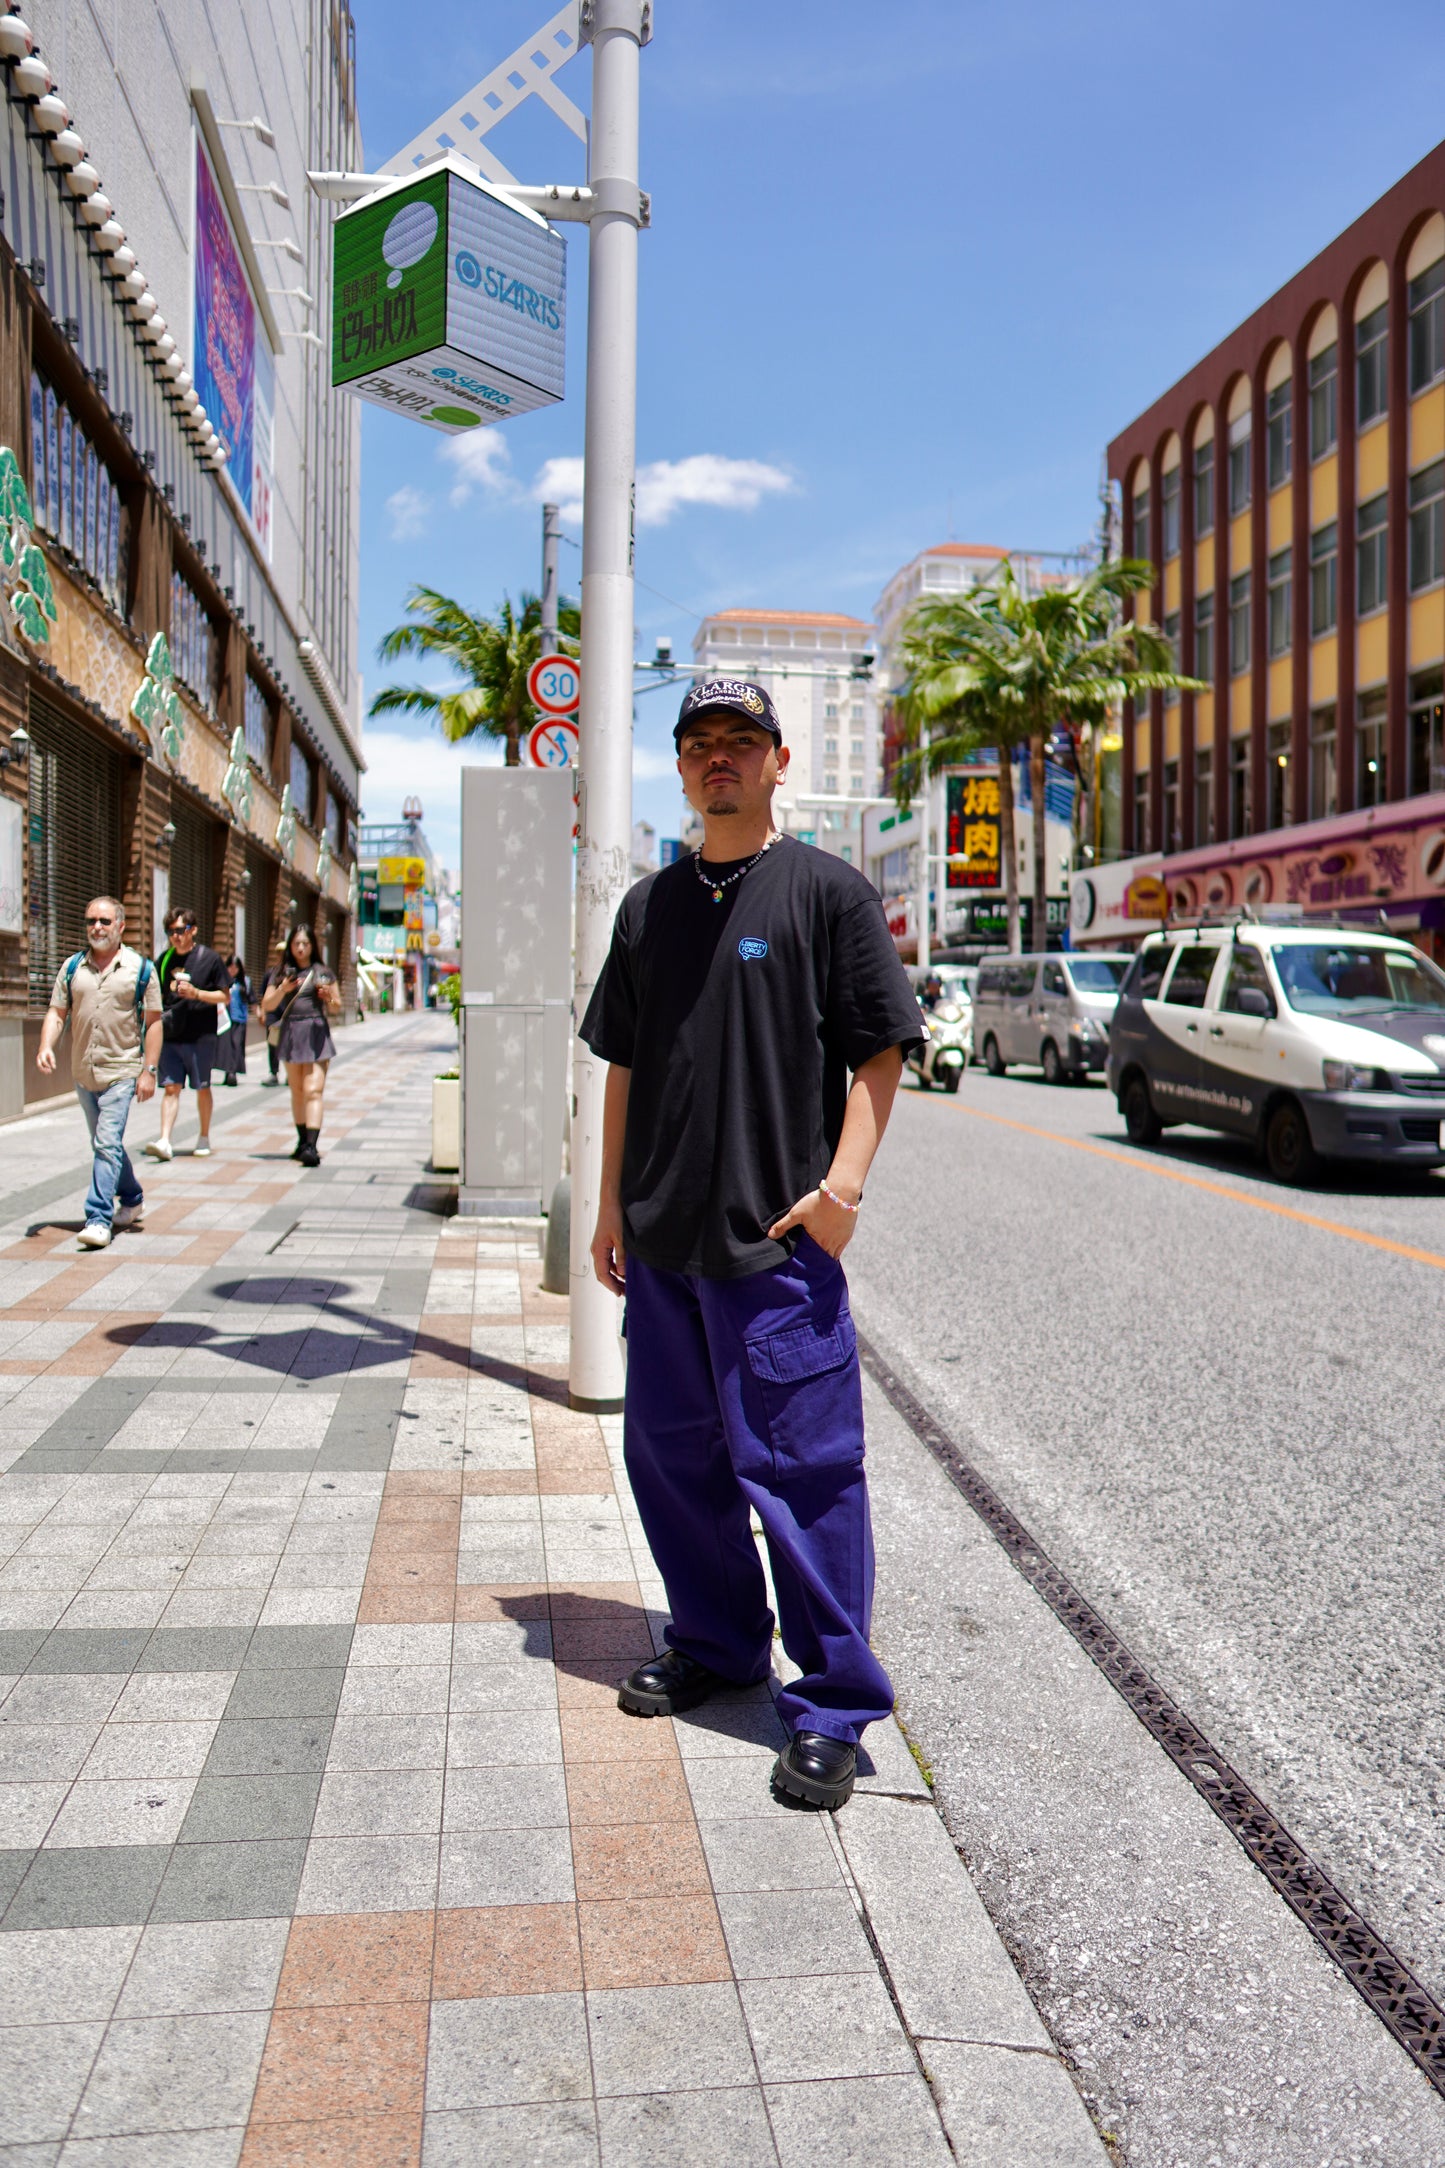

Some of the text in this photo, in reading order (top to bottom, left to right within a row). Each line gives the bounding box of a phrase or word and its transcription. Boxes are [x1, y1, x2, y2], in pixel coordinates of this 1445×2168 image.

[484, 266, 560, 330] STARTS
[342, 287, 418, 363] ピタットハウス
[356, 377, 436, 412] ピタットハウス
[451, 376, 516, 405] STARTS
[542, 672, 574, 698] 30
[688, 681, 757, 709] XLARGE
[963, 777, 1000, 858] 焼肉
[949, 871, 997, 887] STEAK
